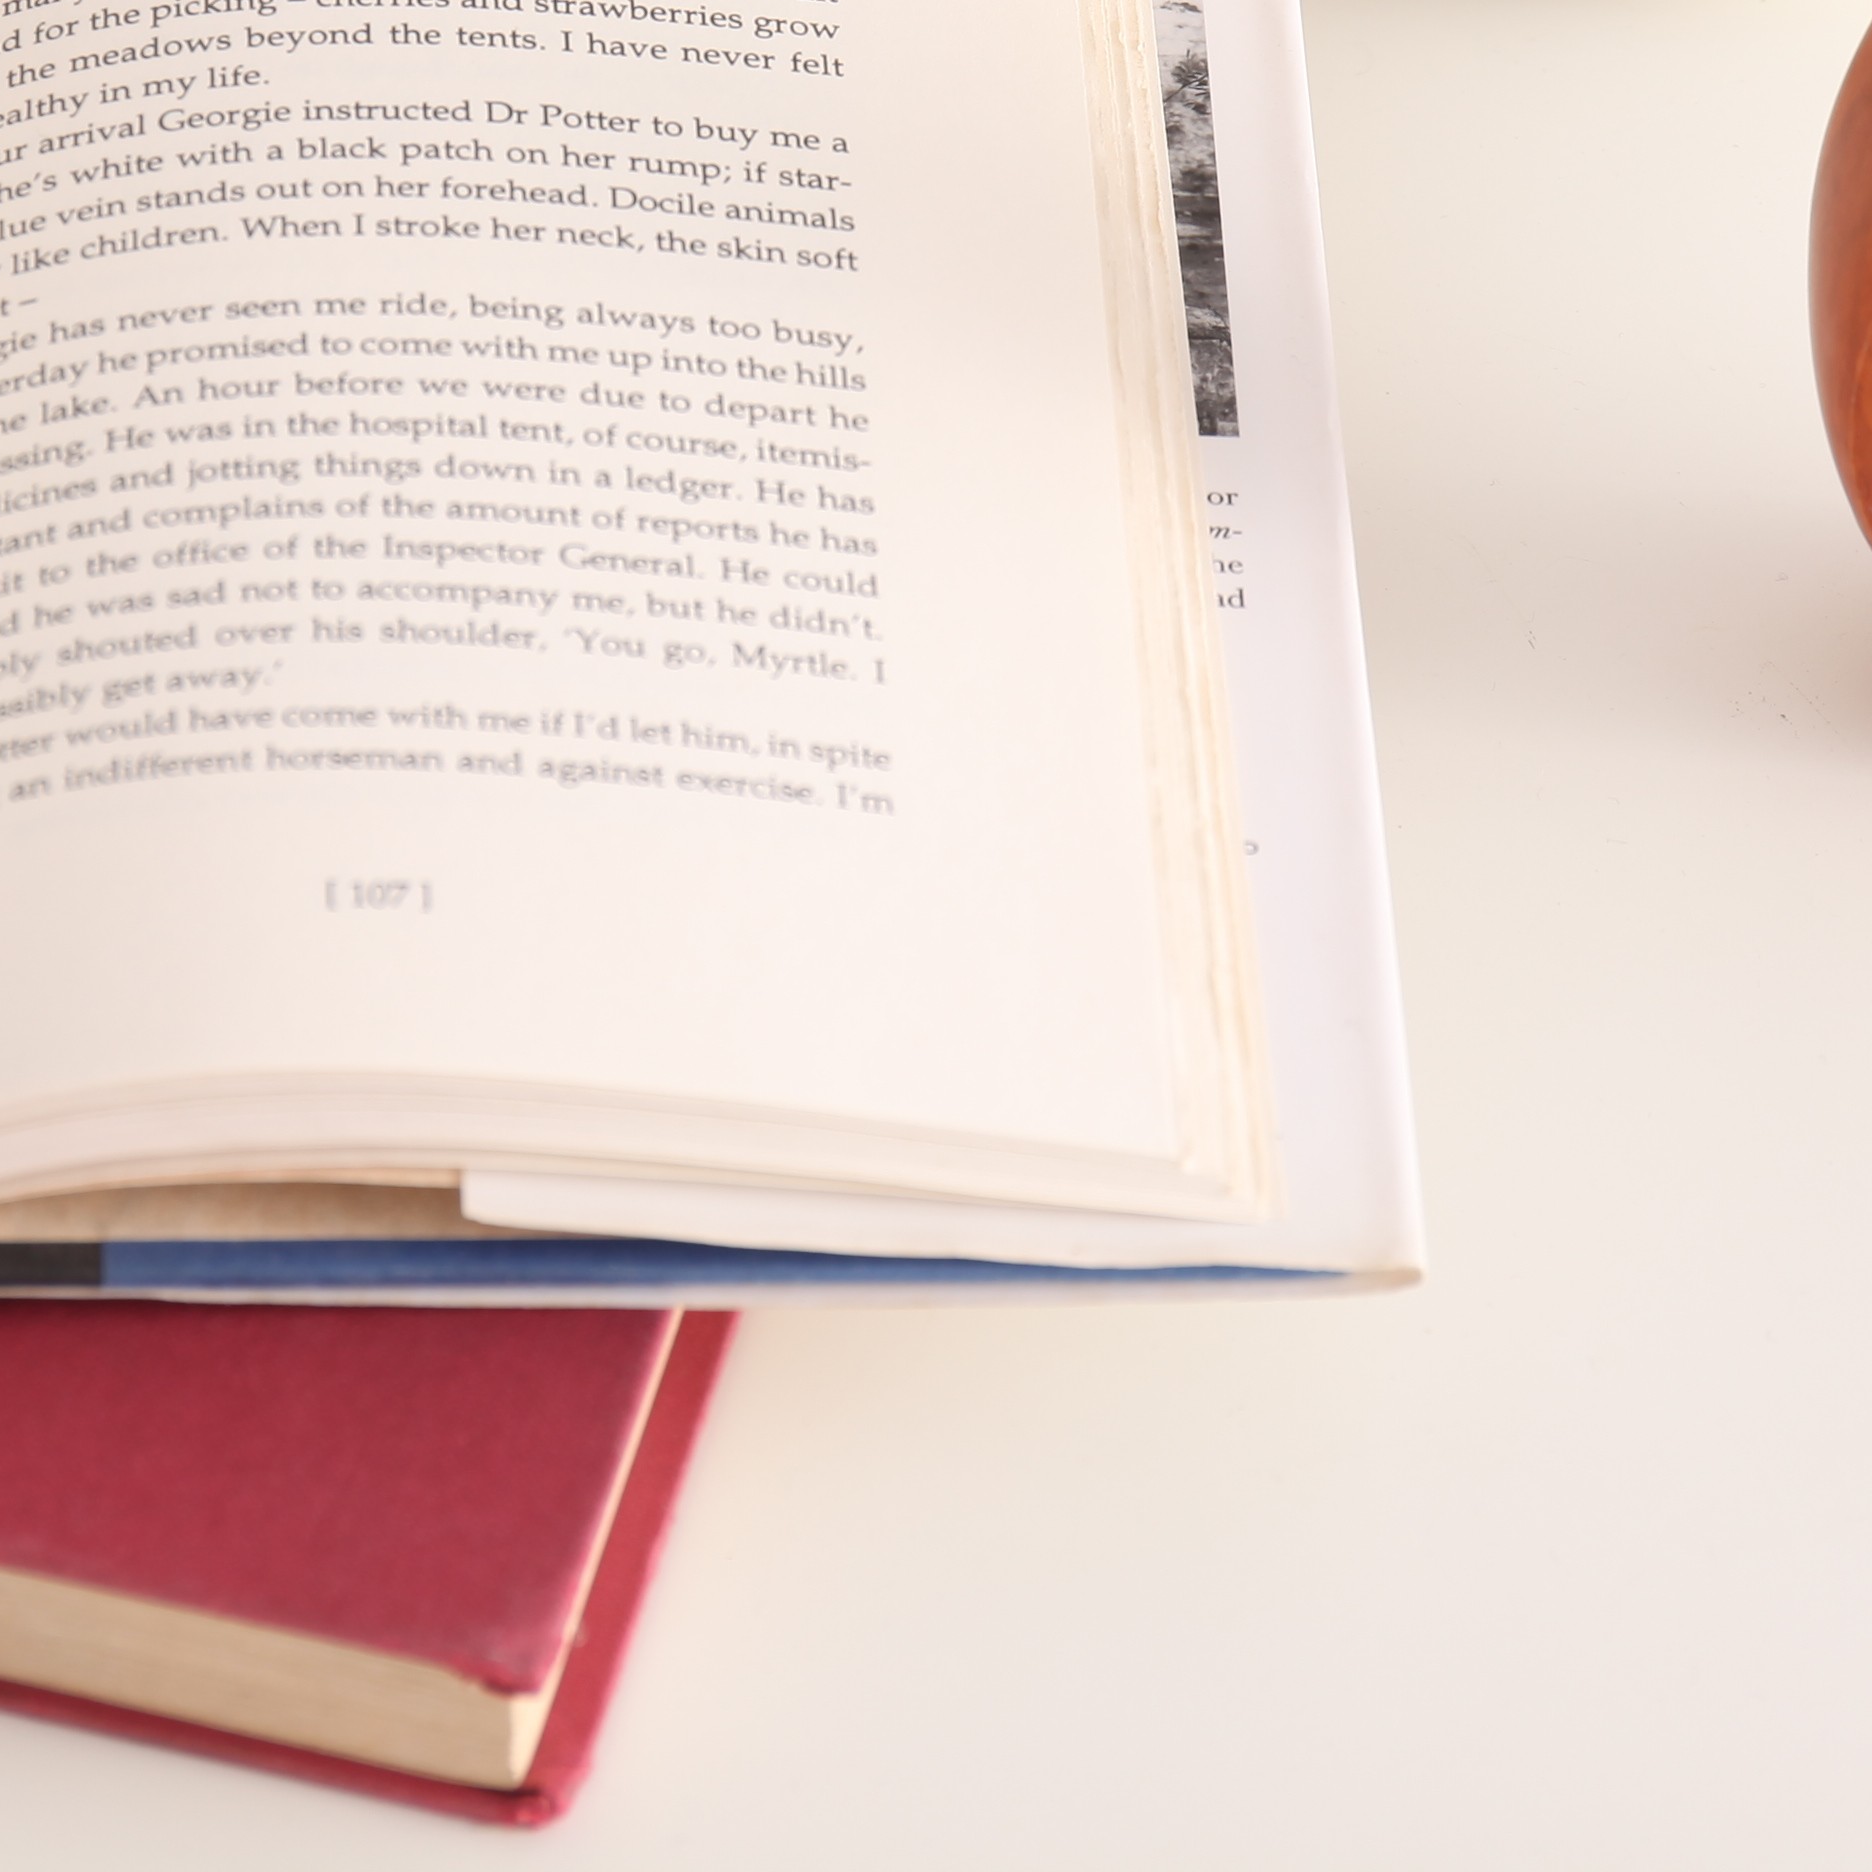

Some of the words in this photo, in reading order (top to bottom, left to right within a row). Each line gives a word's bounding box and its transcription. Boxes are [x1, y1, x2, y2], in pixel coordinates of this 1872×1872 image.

[6, 62, 56, 89] the
[69, 34, 232, 73] meadows
[244, 22, 374, 54] beyond
[389, 22, 442, 46] the
[455, 26, 546, 51] tents.
[561, 30, 573, 53] I
[586, 31, 668, 60] have
[680, 46, 776, 70] never
[790, 51, 845, 78] felt
[33, 19, 80, 45] for
[89, 7, 141, 31] the
[753, 16, 841, 40] grow
[99, 82, 132, 105] in
[142, 75, 197, 100] my
[207, 64, 270, 89] life.
[38, 113, 146, 155] arrival
[157, 100, 292, 132] Georgie
[303, 99, 473, 123] instructed
[485, 100, 529, 125] Dr
[540, 104, 641, 134] Potter
[651, 116, 684, 137] to
[693, 116, 759, 152] buy
[769, 130, 821, 151] me
[832, 137, 850, 154] a
[69, 154, 164, 185] white
[176, 140, 254, 168] with
[266, 144, 284, 161] a
[296, 136, 387, 160] black
[400, 138, 494, 167] patch
[506, 147, 549, 165] on
[561, 143, 616, 170] her
[629, 156, 731, 187] rump;
[743, 160, 767, 184] if
[778, 168, 852, 192] star-
[56, 197, 127, 225] vein
[136, 180, 246, 213] stands
[255, 178, 312, 201] out
[321, 180, 365, 198] on
[375, 174, 430, 198] her
[441, 176, 598, 208] forehead.
[609, 186, 715, 218] Docile
[725, 201, 856, 232] animals
[11, 247, 71, 276] like
[79, 225, 228, 260] children.
[240, 214, 343, 239] When
[354, 213, 364, 236] I
[375, 214, 481, 239] stroke
[491, 216, 547, 242] her
[556, 225, 644, 253] neck,
[655, 229, 707, 256] the
[717, 236, 787, 265] skin
[796, 247, 858, 272] soft
[49, 318, 107, 345] has
[117, 304, 214, 332] never
[225, 299, 301, 320] seen
[314, 297, 367, 316] me
[380, 291, 457, 319] ride,
[468, 293, 565, 329] being
[576, 301, 696, 339] always
[708, 315, 762, 340] too
[772, 318, 864, 357] busy,
[97, 350, 139, 375] he
[145, 331, 309, 376] promised
[320, 335, 353, 355] to
[359, 337, 453, 357] come
[461, 335, 539, 361] with
[547, 345, 600, 365] me
[608, 349, 653, 377] up
[662, 348, 727, 376] into
[736, 356, 788, 383] the
[795, 360, 867, 391] hills
[40, 395, 116, 425] lake.
[133, 384, 185, 409] An
[197, 376, 280, 402] hour
[294, 371, 405, 396] before
[417, 378, 469, 397] we
[481, 380, 566, 403] were
[579, 381, 645, 409] due
[659, 391, 692, 412] to
[704, 392, 816, 428] depart
[828, 404, 870, 432] he
